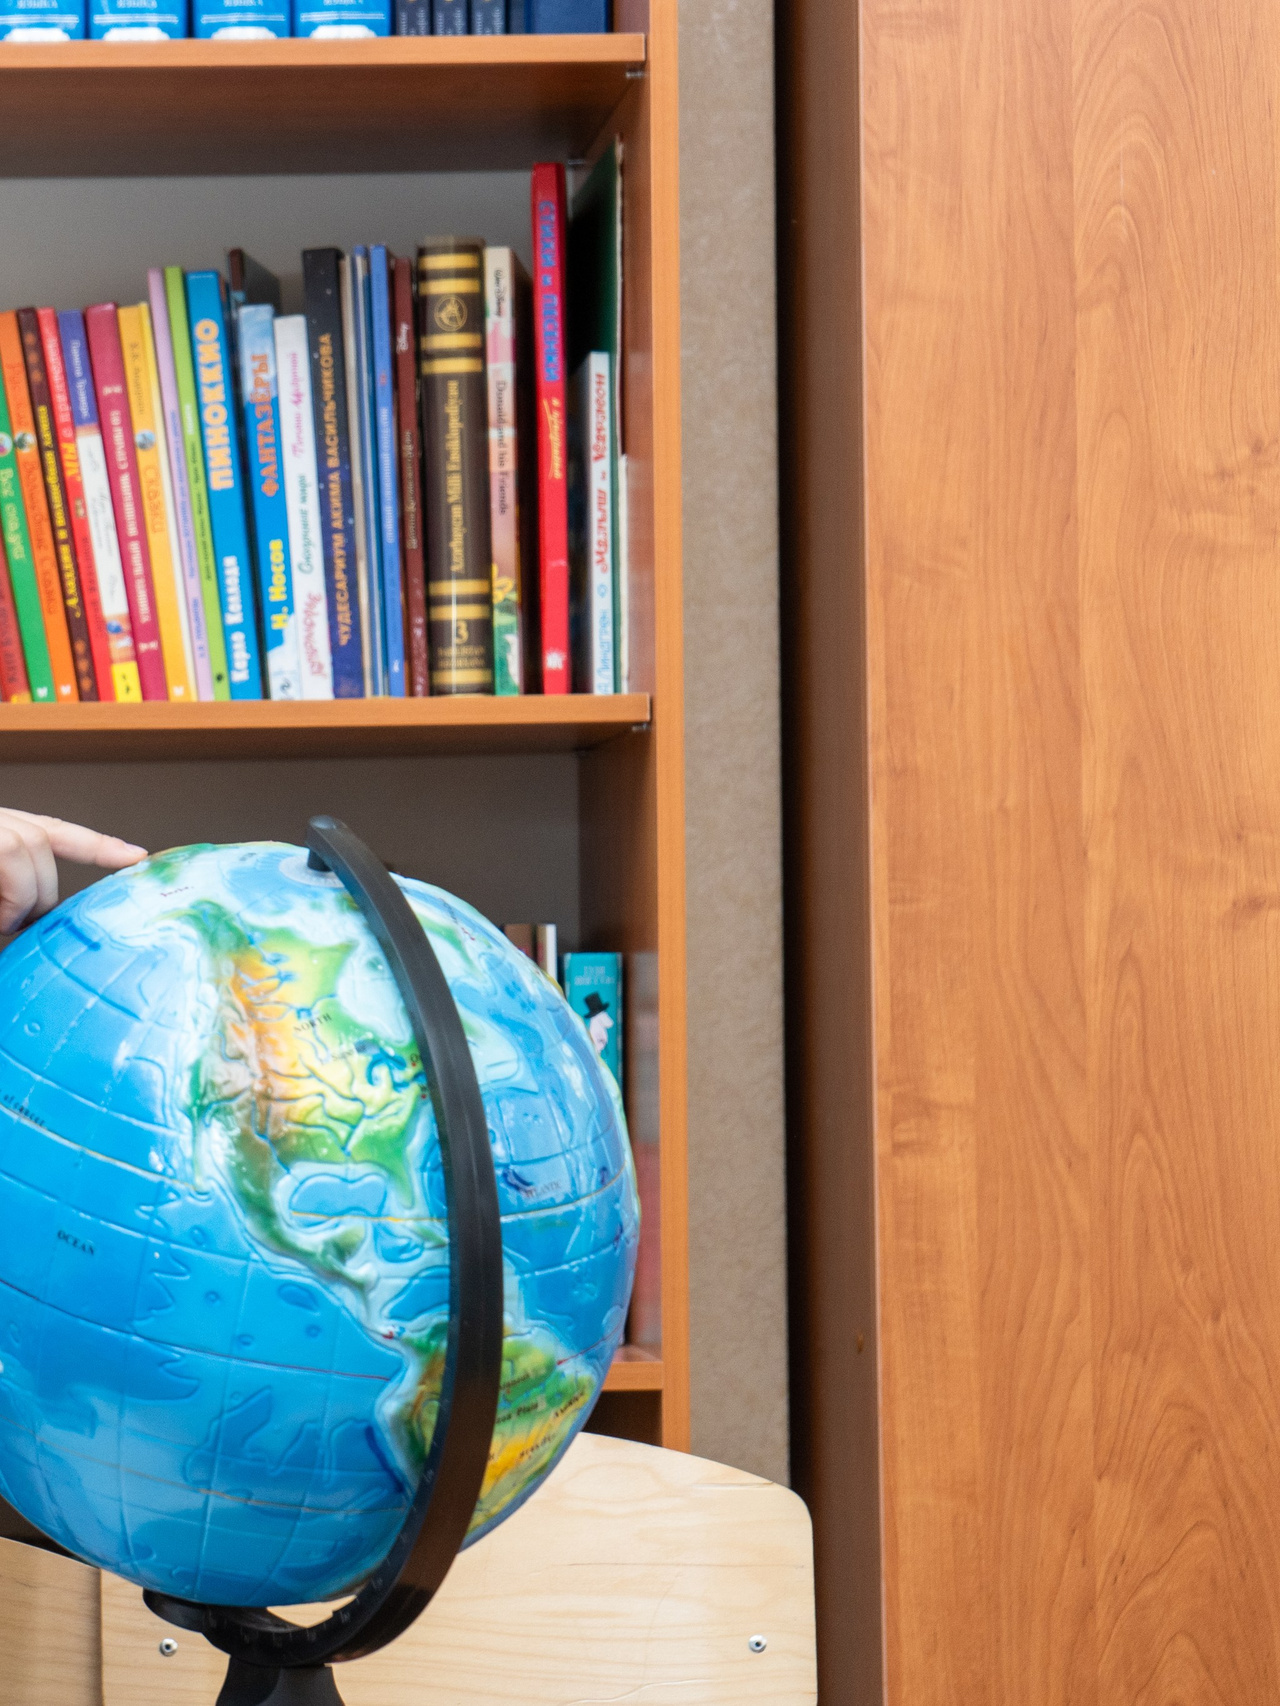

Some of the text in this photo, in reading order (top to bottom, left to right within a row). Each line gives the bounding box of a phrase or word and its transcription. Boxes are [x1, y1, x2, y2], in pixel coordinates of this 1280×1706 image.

[538, 200, 556, 267] СТИХИ
[540, 274, 552, 286] и
[393, 320, 411, 354] Disney
[541, 293, 560, 382] ПЕСЕНКИ
[192, 317, 235, 490] ПИНОККИО
[495, 380, 507, 424] Donald
[590, 371, 607, 462] Карлсон
[496, 427, 508, 449] and
[37, 404, 81, 619] Аладдин и волшебная лампа
[118, 471, 137, 537] ВОЛШЕБНИК
[245, 351, 290, 629] Н. Носов ФАНТАЗЁРЫ
[319, 331, 352, 645] ЧУДЕСАРИУМ АКИМА ВАСИЛЬЧИКОВА
[446, 472, 462, 503] Milli
[497, 471, 509, 516] Friends
[593, 486, 609, 573] Малыш
[128, 540, 151, 623] УДИВИТЕЛЬНЫЙ
[218, 554, 244, 625] Коллоди
[226, 629, 252, 681] Карло
[452, 619, 469, 645] 3
[54, 1228, 98, 1255] OCEAN
